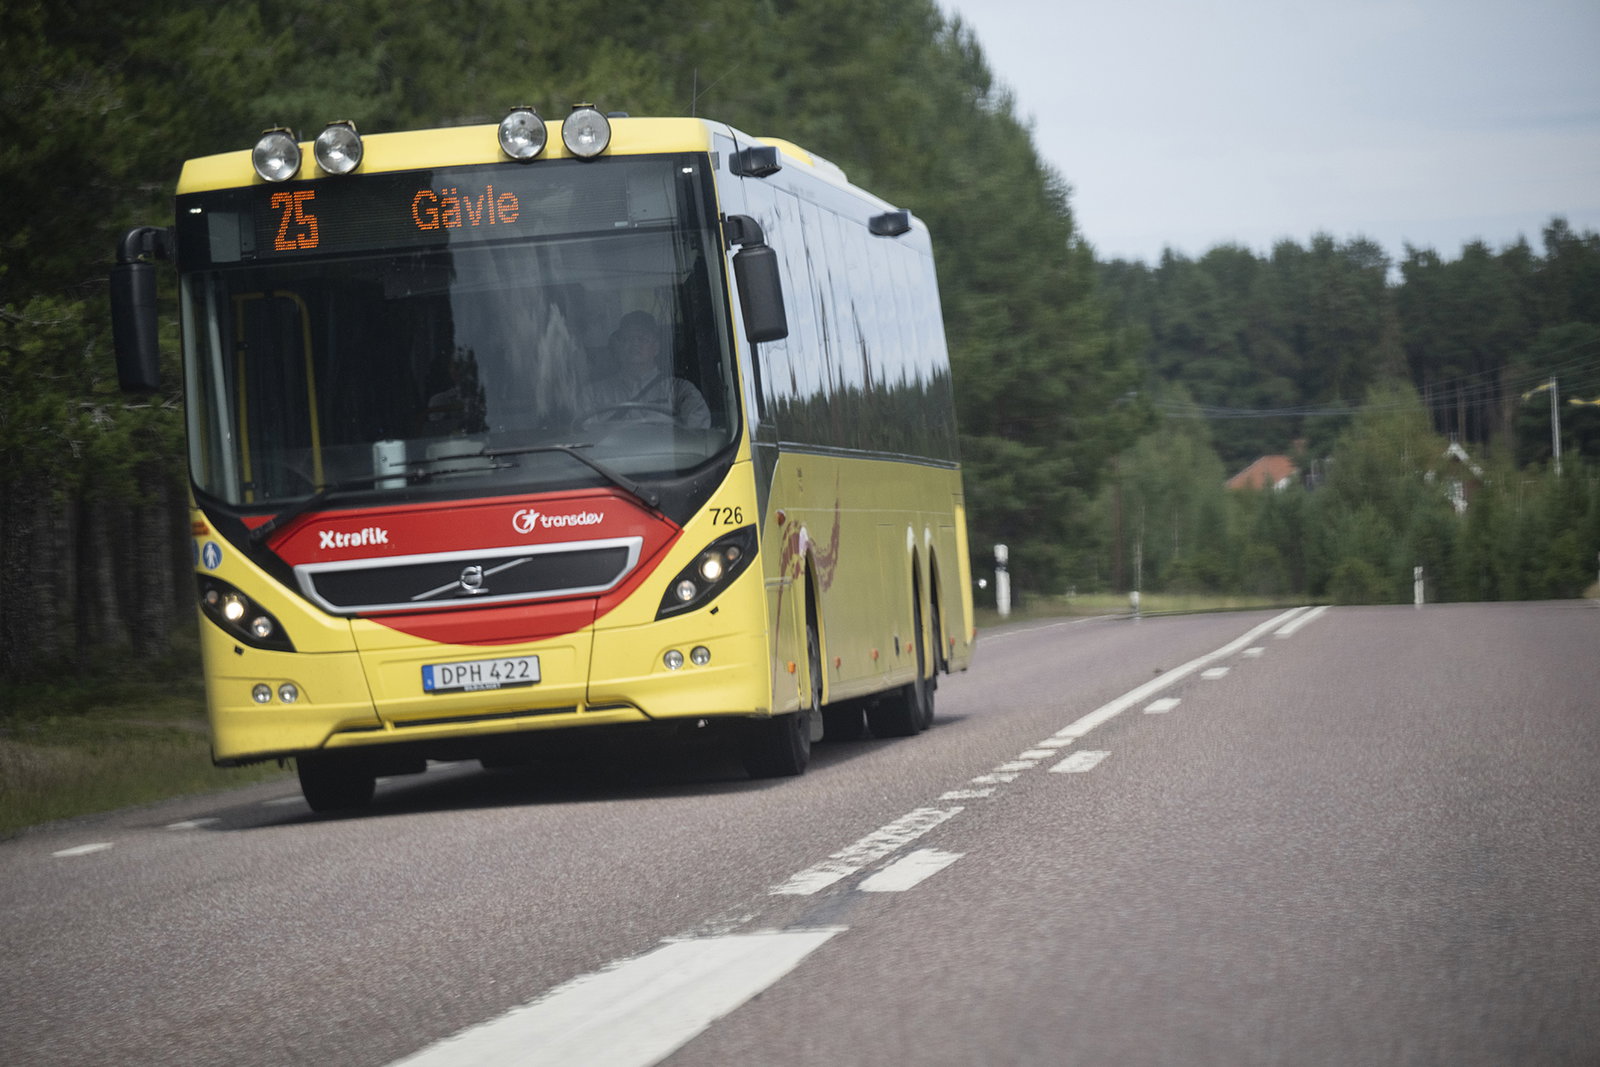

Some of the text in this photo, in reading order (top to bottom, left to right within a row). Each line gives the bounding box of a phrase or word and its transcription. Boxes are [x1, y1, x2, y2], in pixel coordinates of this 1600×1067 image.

[411, 185, 519, 230] Gävle
[271, 190, 319, 251] 25
[540, 511, 604, 528] transdev
[709, 506, 743, 526] 726
[319, 527, 389, 549] Xtrafik
[441, 660, 530, 685] DPH 422
